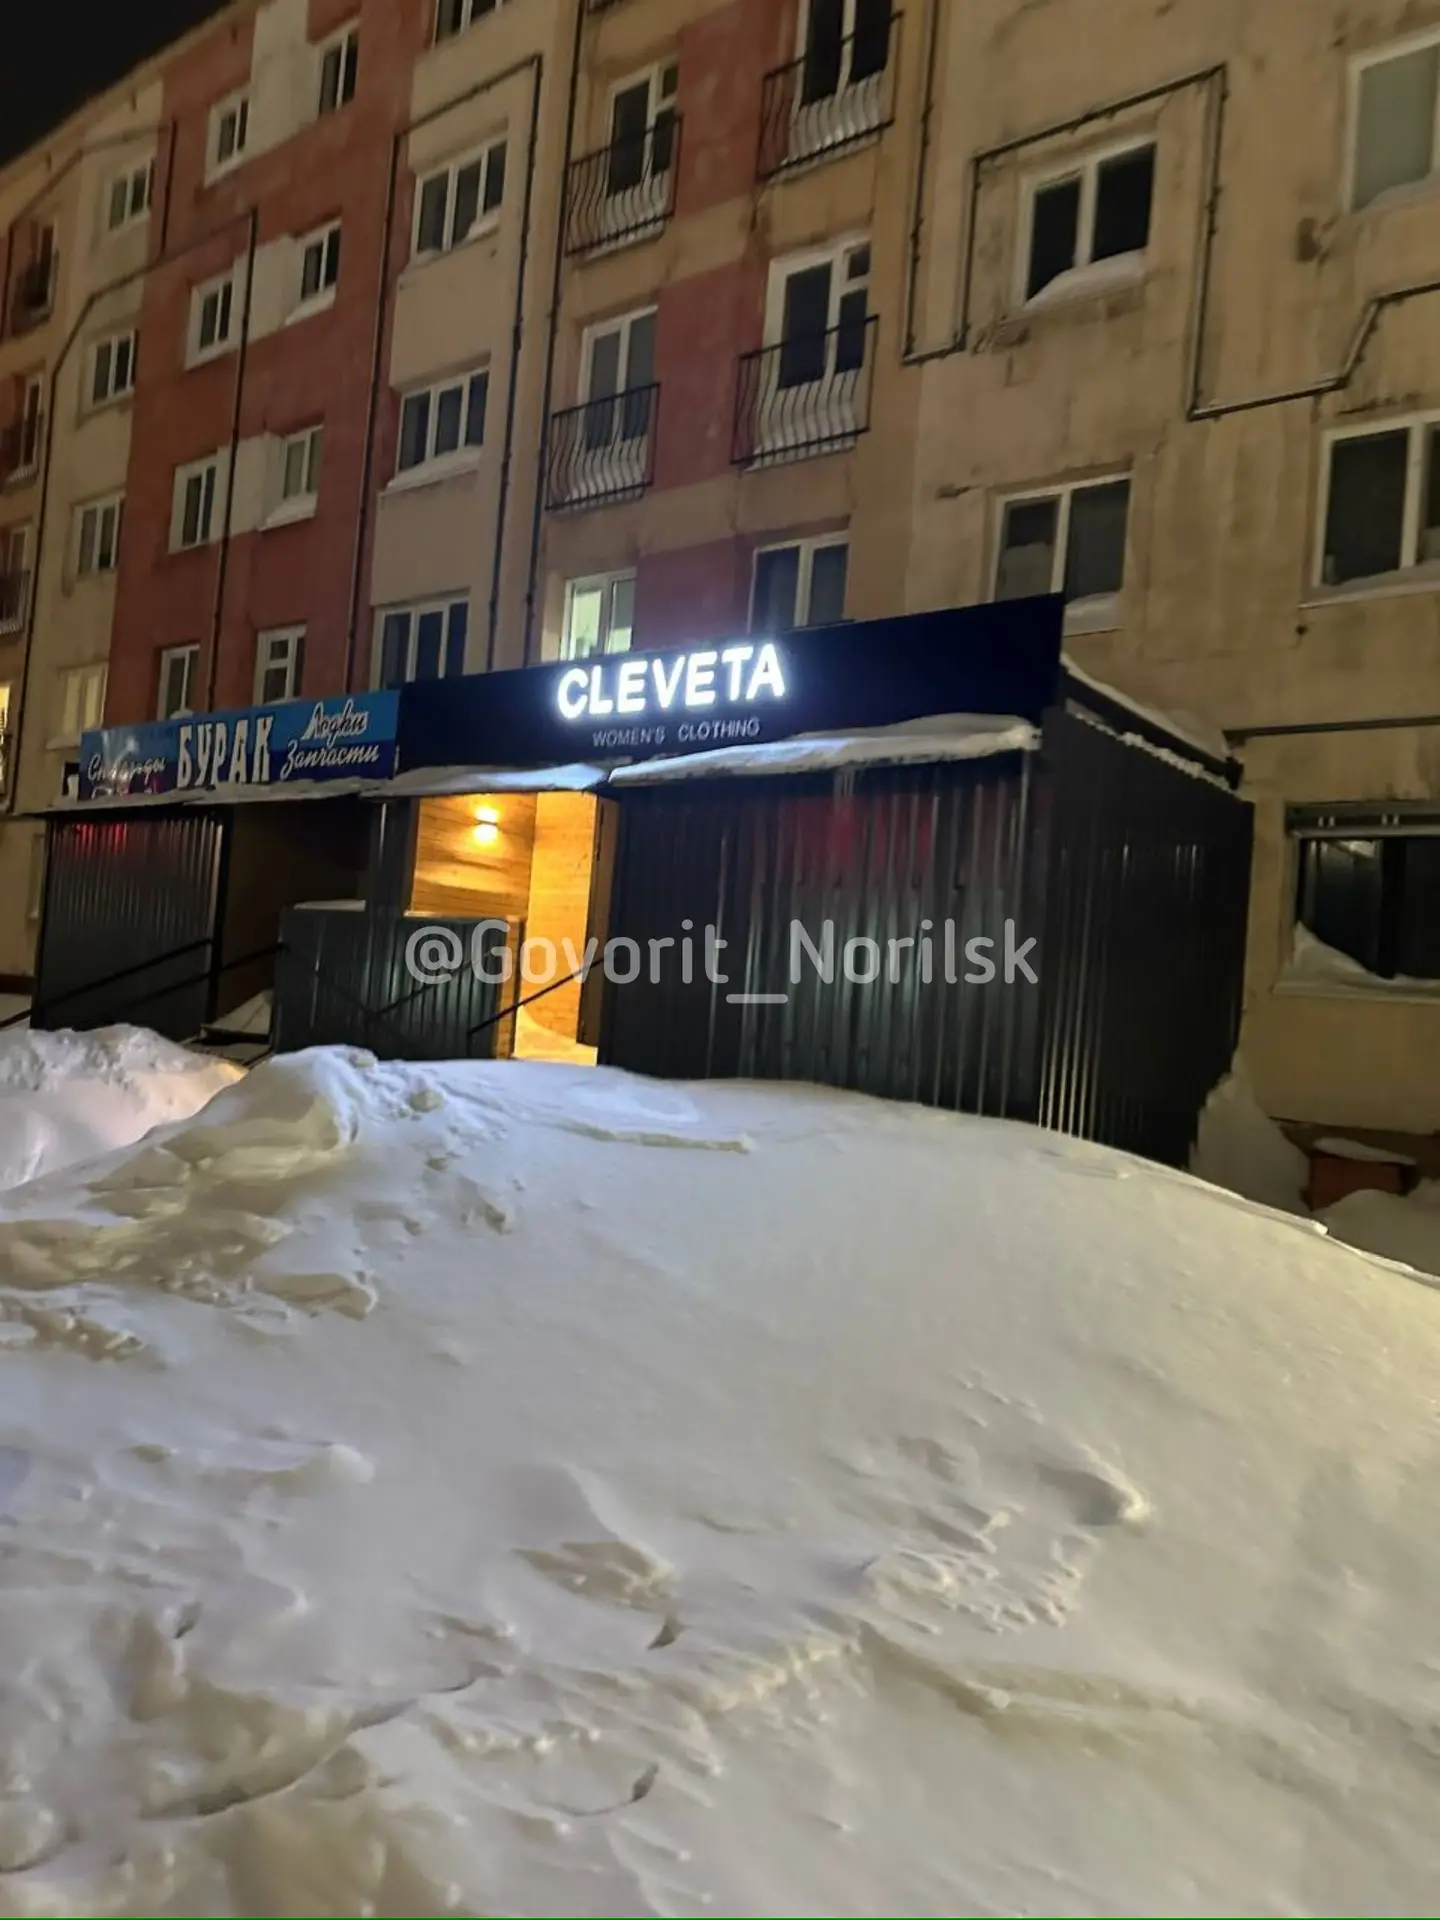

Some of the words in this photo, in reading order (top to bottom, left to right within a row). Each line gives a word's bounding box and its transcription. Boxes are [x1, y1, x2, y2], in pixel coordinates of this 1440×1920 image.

[557, 643, 786, 719] CLEVETA
[301, 698, 369, 748] Лодки
[592, 726, 666, 747] WOMEN'S
[678, 717, 760, 742] CLOTHING
[176, 716, 274, 788] БУРАК
[280, 739, 380, 780] Запчасти
